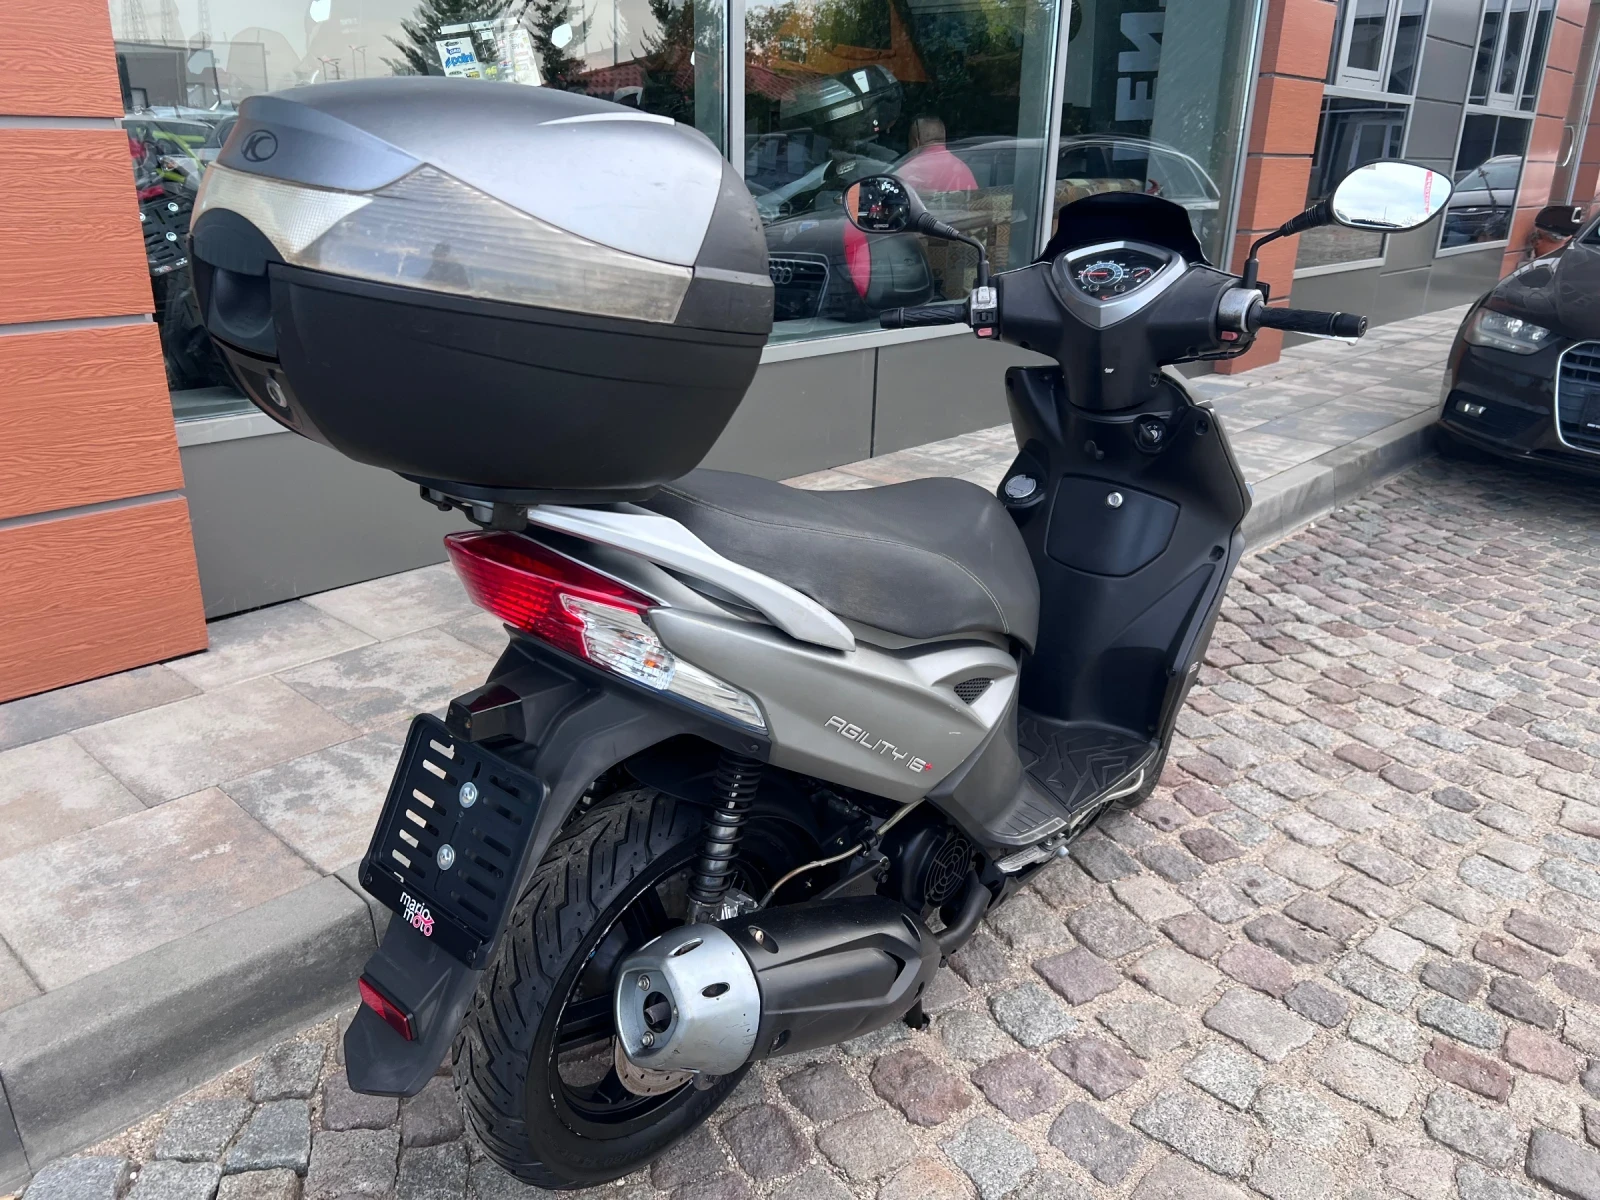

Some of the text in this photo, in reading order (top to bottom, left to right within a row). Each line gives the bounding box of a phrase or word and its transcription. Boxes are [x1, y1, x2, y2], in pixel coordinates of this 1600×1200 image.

[824, 715, 908, 761] AGILITY
[400, 891, 430, 920] mario
[403, 907, 433, 937] moto
